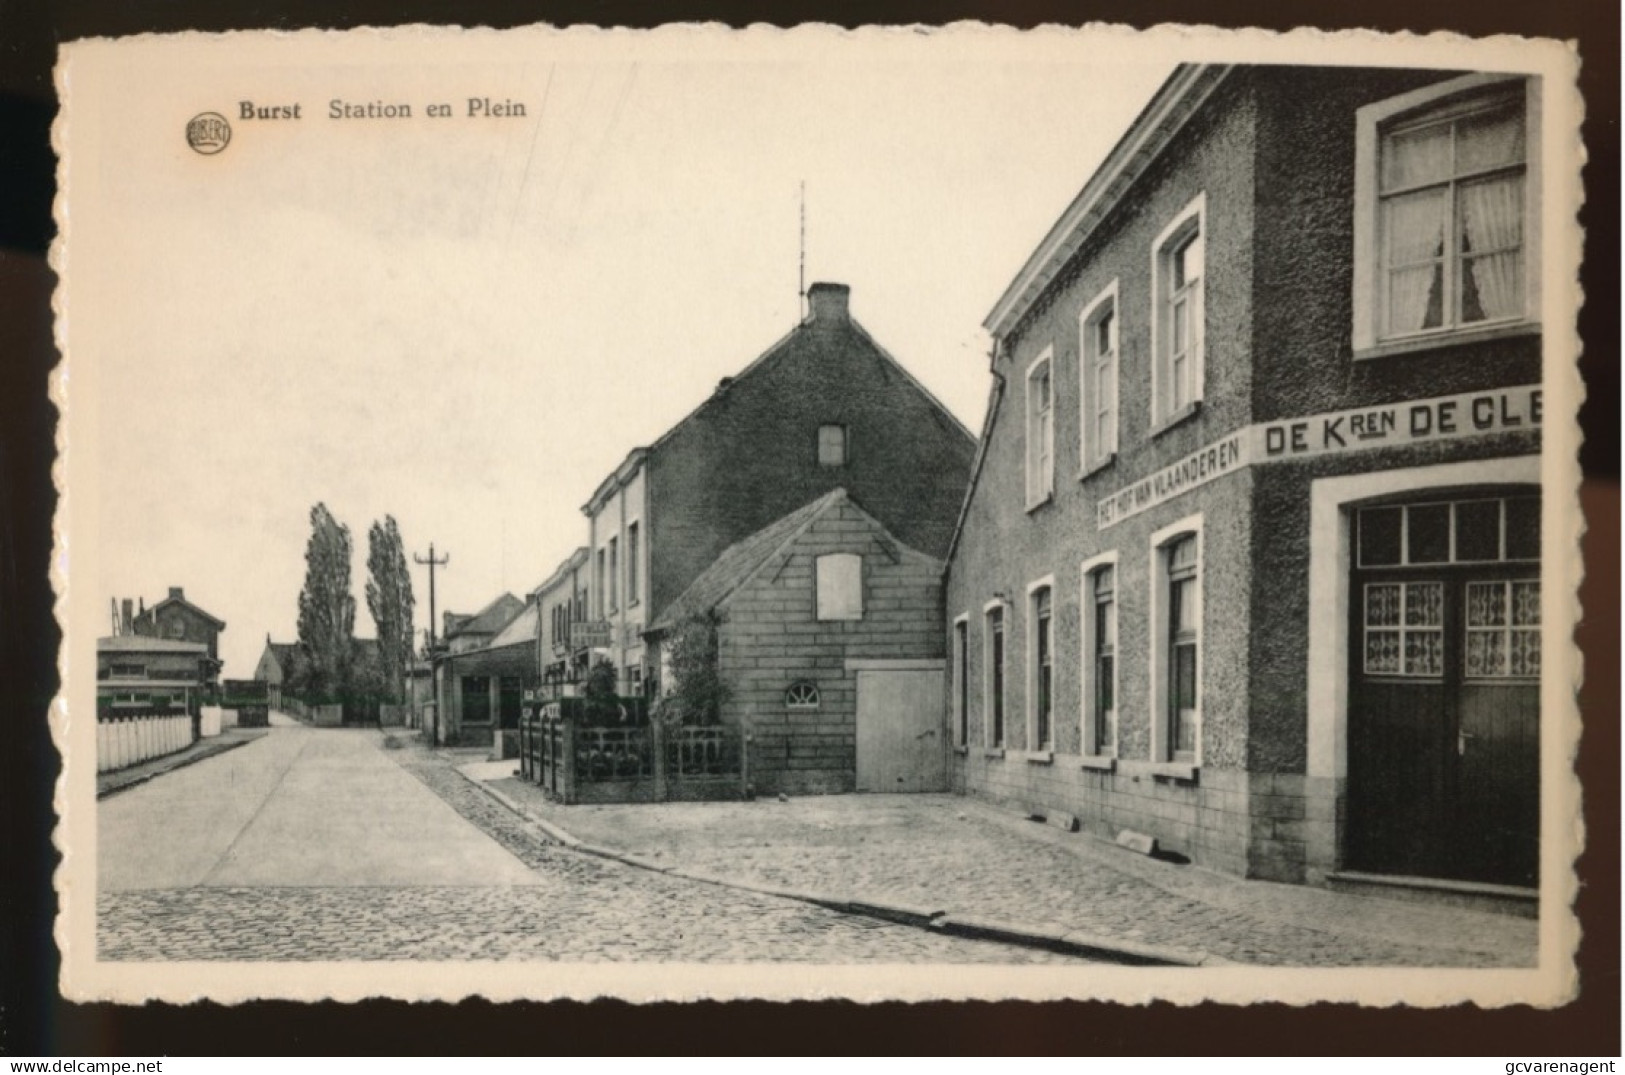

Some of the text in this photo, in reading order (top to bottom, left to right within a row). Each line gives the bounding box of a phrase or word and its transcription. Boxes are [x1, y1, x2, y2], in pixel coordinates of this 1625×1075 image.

[1266, 422, 1309, 456] DE
[1409, 401, 1458, 438] DE
[1154, 436, 1239, 500] VLAANDEREN
